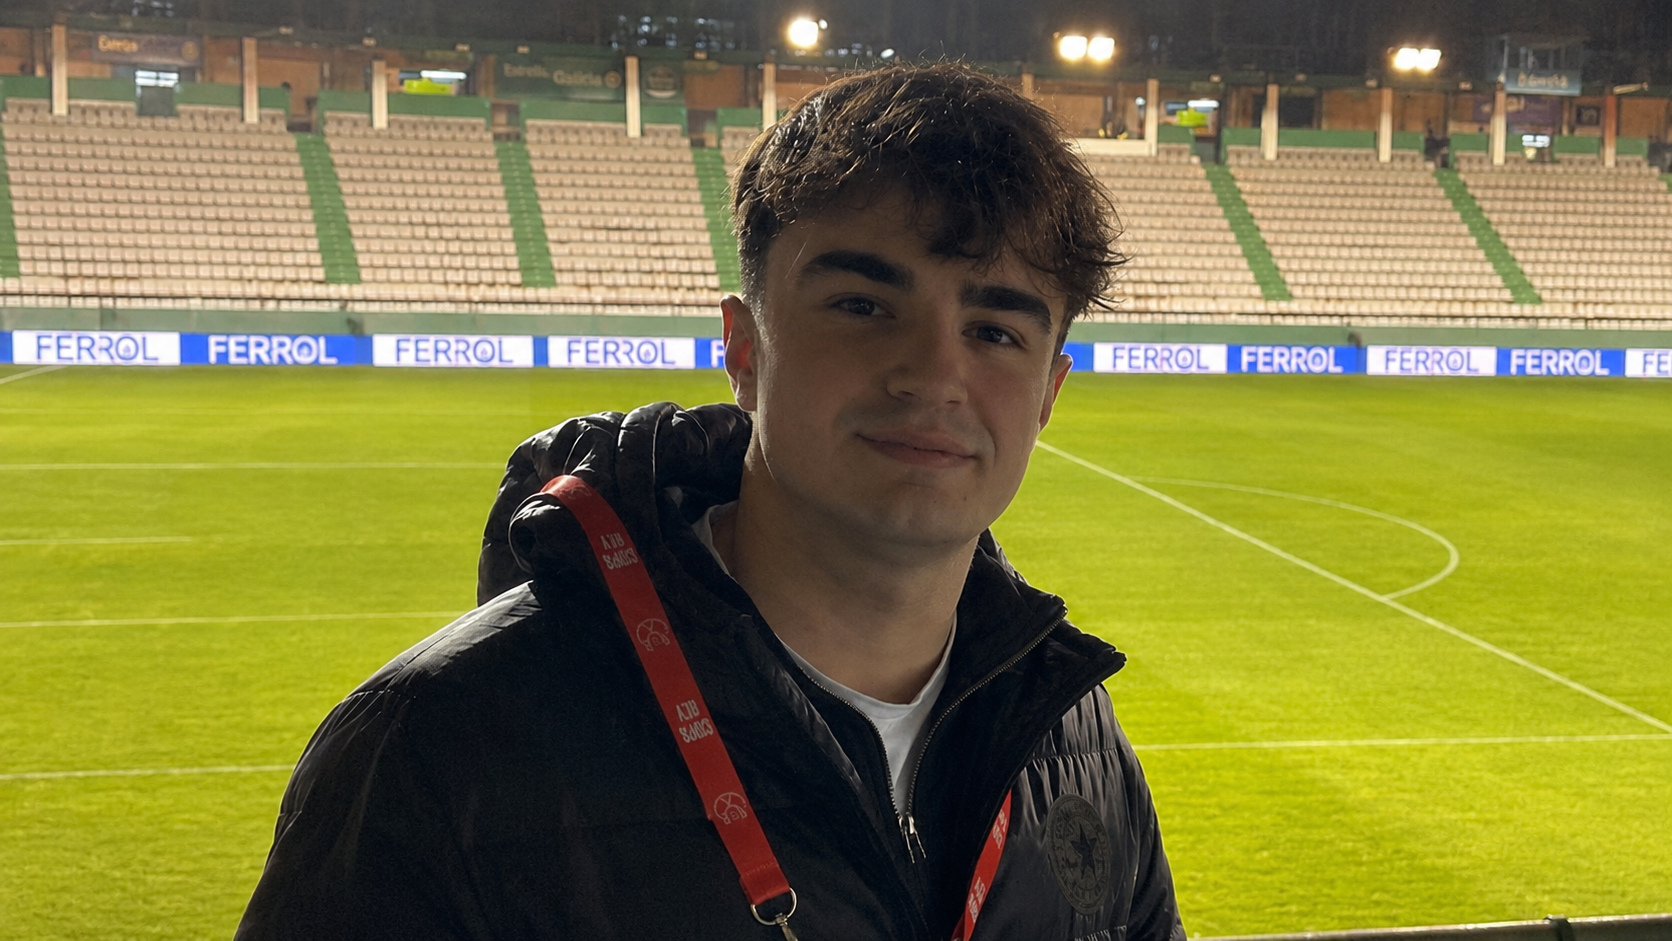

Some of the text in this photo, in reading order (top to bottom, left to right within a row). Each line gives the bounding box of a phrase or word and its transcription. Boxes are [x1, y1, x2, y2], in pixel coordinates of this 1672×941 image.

[36, 334, 159, 361] FERROL
[208, 334, 338, 365] FERROL
[395, 338, 514, 364] FERROL
[566, 339, 676, 365] FERROL
[1112, 345, 1209, 371] FERROL
[1241, 346, 1343, 373] FERROL
[1385, 350, 1479, 375] FERROL
[1510, 349, 1610, 375] FERROL
[1643, 351, 1672, 376] FE
